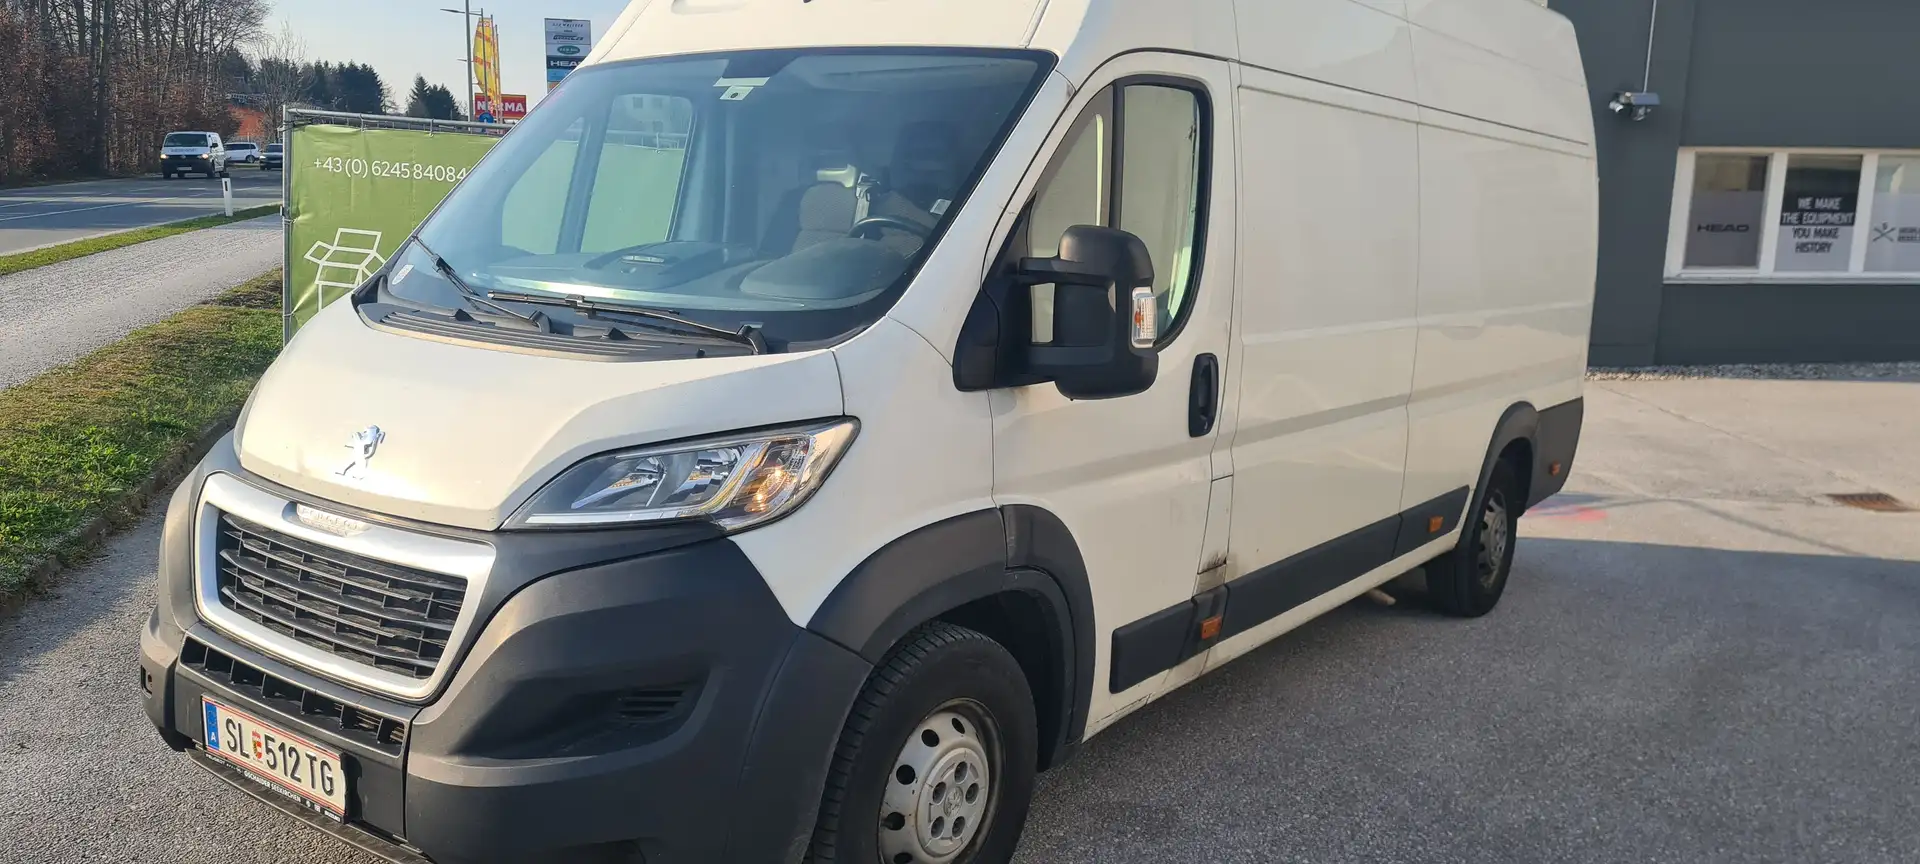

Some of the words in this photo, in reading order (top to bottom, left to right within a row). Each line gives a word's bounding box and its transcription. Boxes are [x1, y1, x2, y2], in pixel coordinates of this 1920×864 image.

[477, 100, 525, 112] NRMA
[313, 157, 342, 173] +43
[371, 160, 410, 179] 6245
[1798, 196, 1813, 210] WE
[1815, 196, 1842, 210] MAKE
[1781, 212, 1800, 224] THE
[1802, 211, 1854, 225] EQUIPMENT
[1697, 223, 1750, 232] HEAD
[1792, 227, 1810, 239] YOU
[1813, 227, 1839, 239] MAKE
[1795, 241, 1833, 253] HISTORY
[210, 731, 217, 743] A
[225, 717, 250, 759] SL
